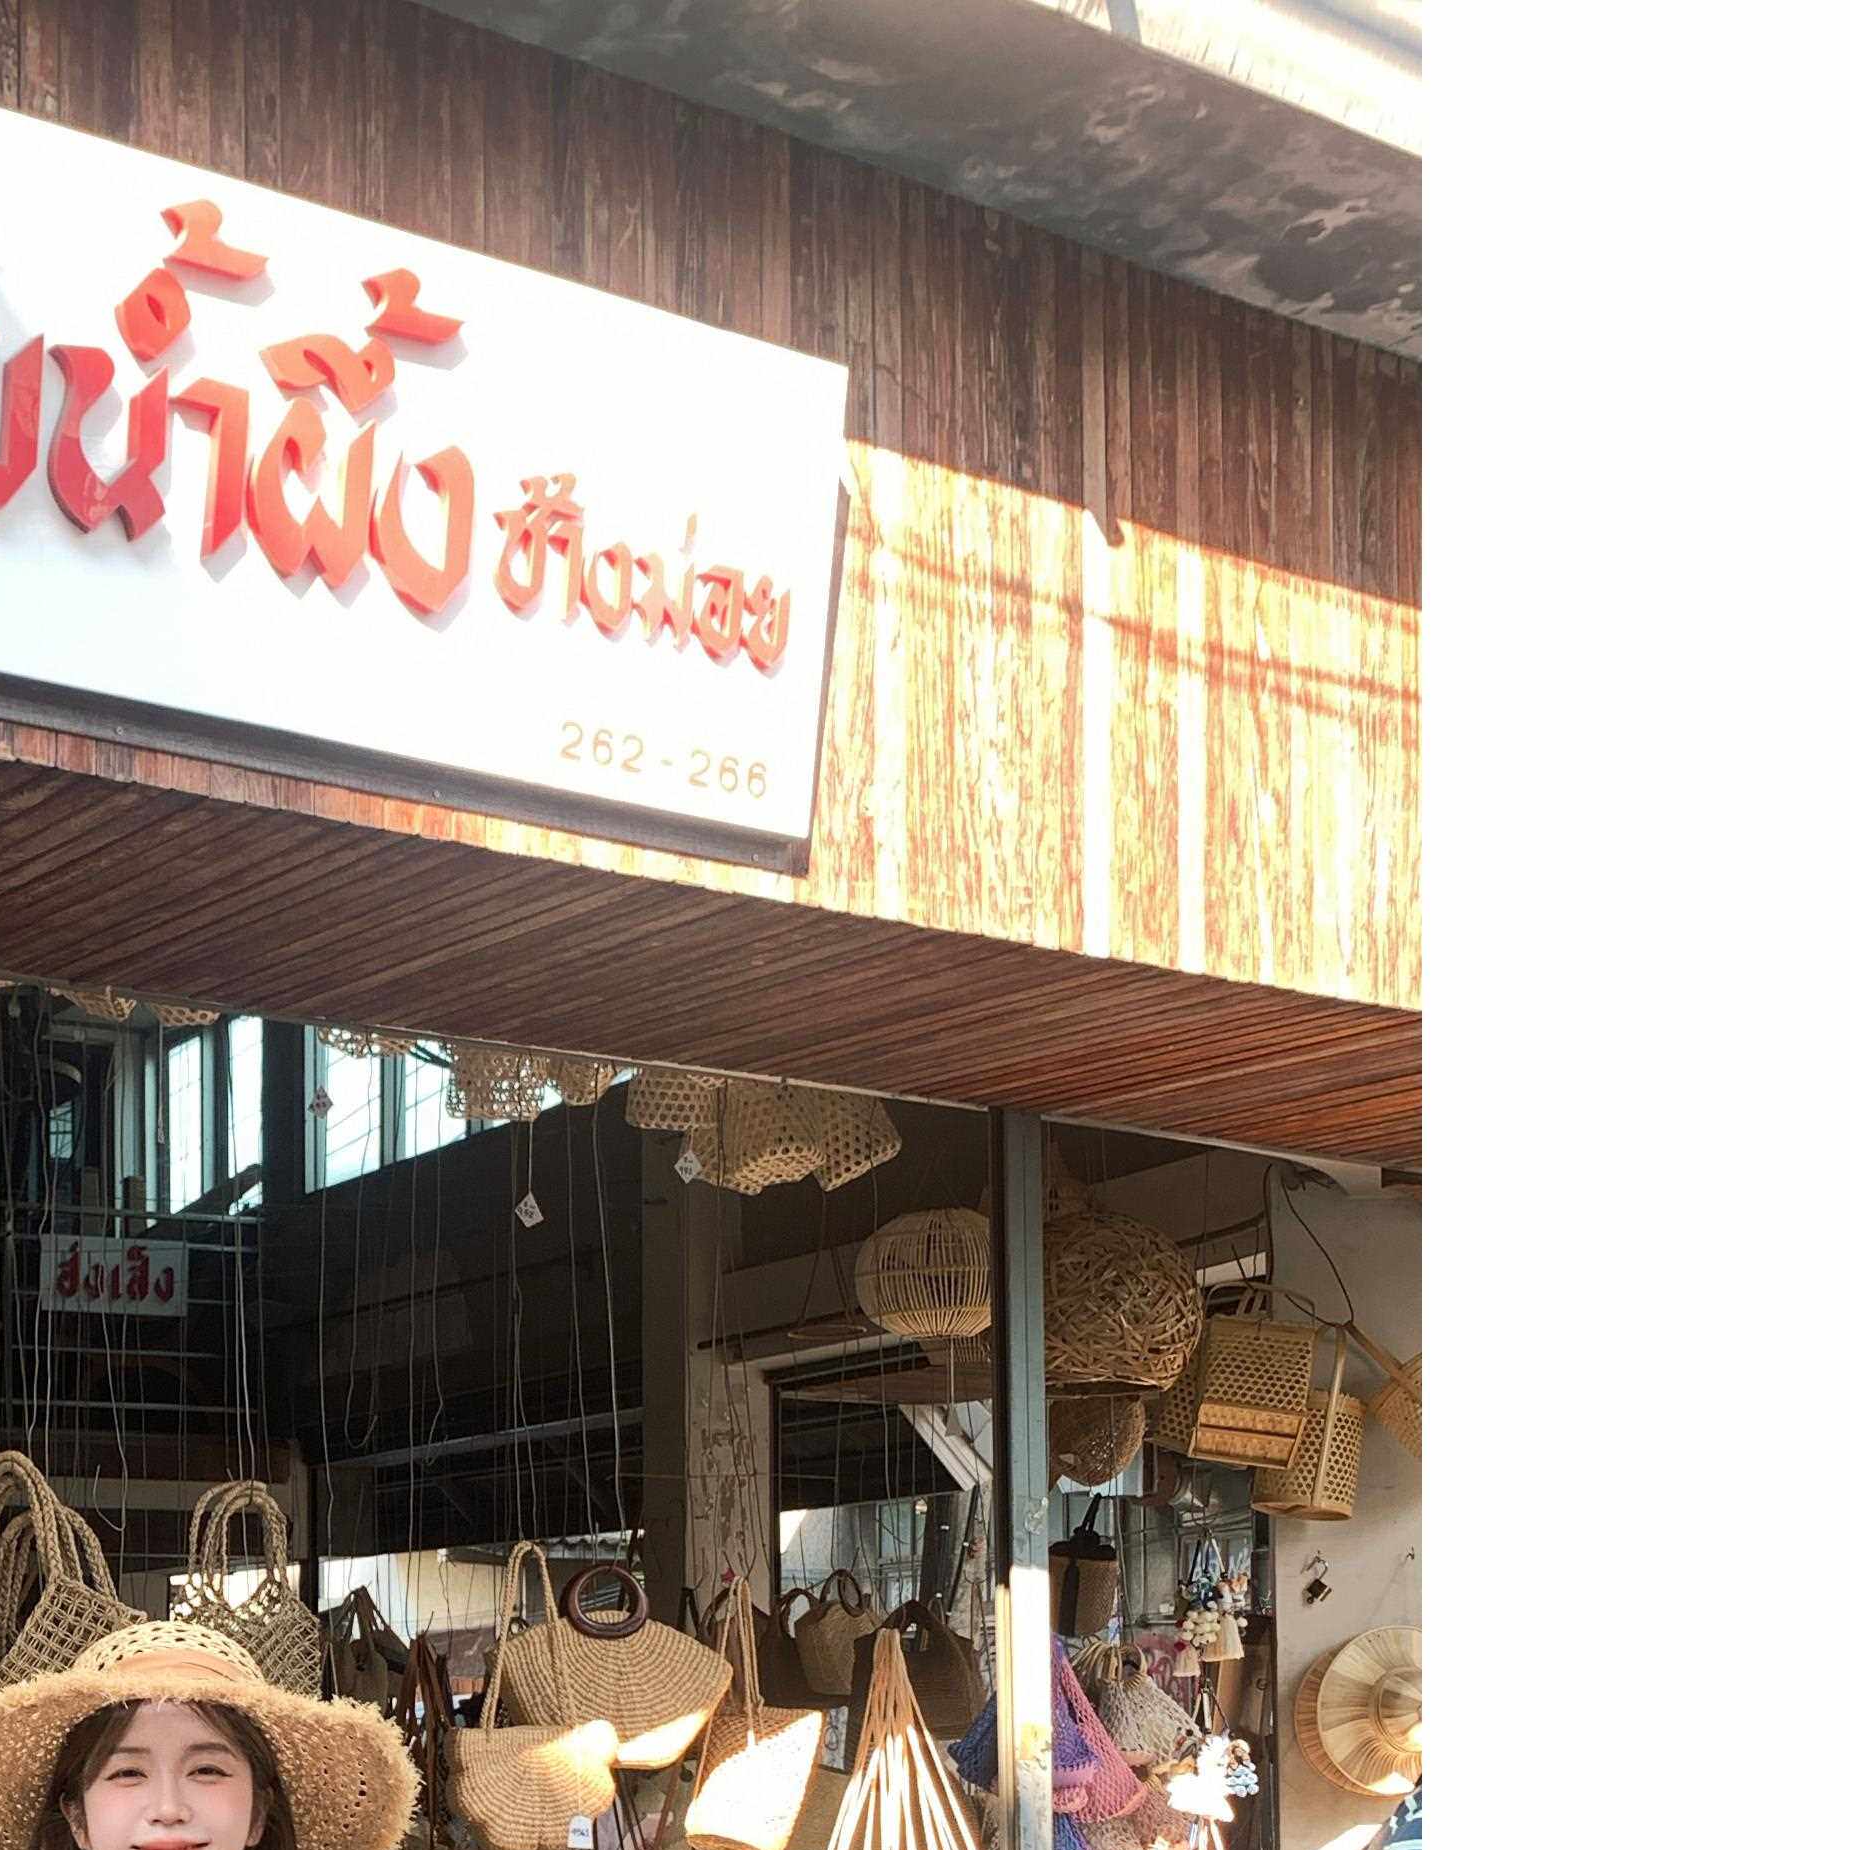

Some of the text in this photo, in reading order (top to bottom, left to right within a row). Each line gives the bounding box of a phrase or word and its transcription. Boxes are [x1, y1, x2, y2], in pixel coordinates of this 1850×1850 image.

[492, 472, 791, 669] ช้างม่อย
[560, 721, 644, 773] 262
[687, 748, 767, 798] 266
